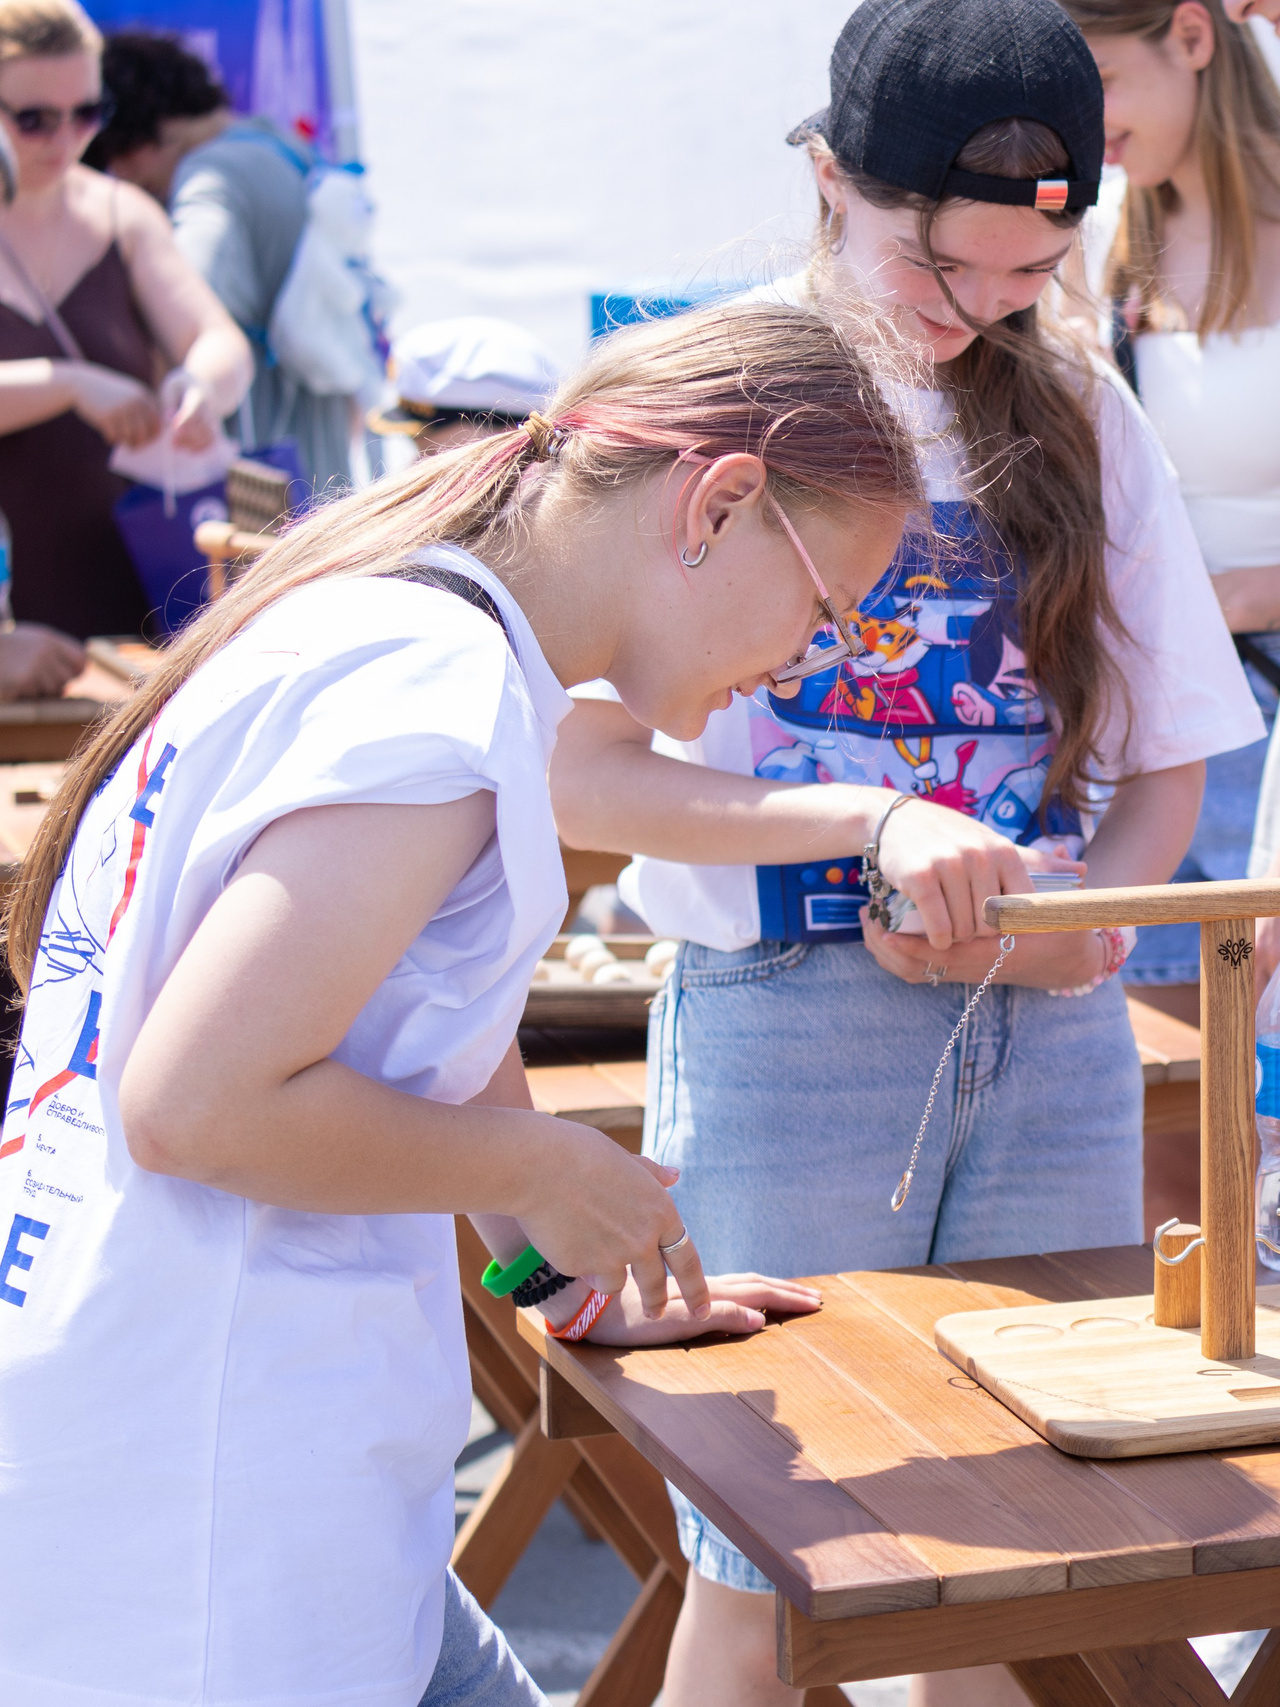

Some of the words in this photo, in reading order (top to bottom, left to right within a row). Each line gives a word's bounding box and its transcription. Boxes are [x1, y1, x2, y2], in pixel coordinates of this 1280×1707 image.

[48, 1100, 78, 1116] ДОБРО
[77, 1111, 85, 1119] И
[36, 1142, 57, 1155] МЕЧТА
